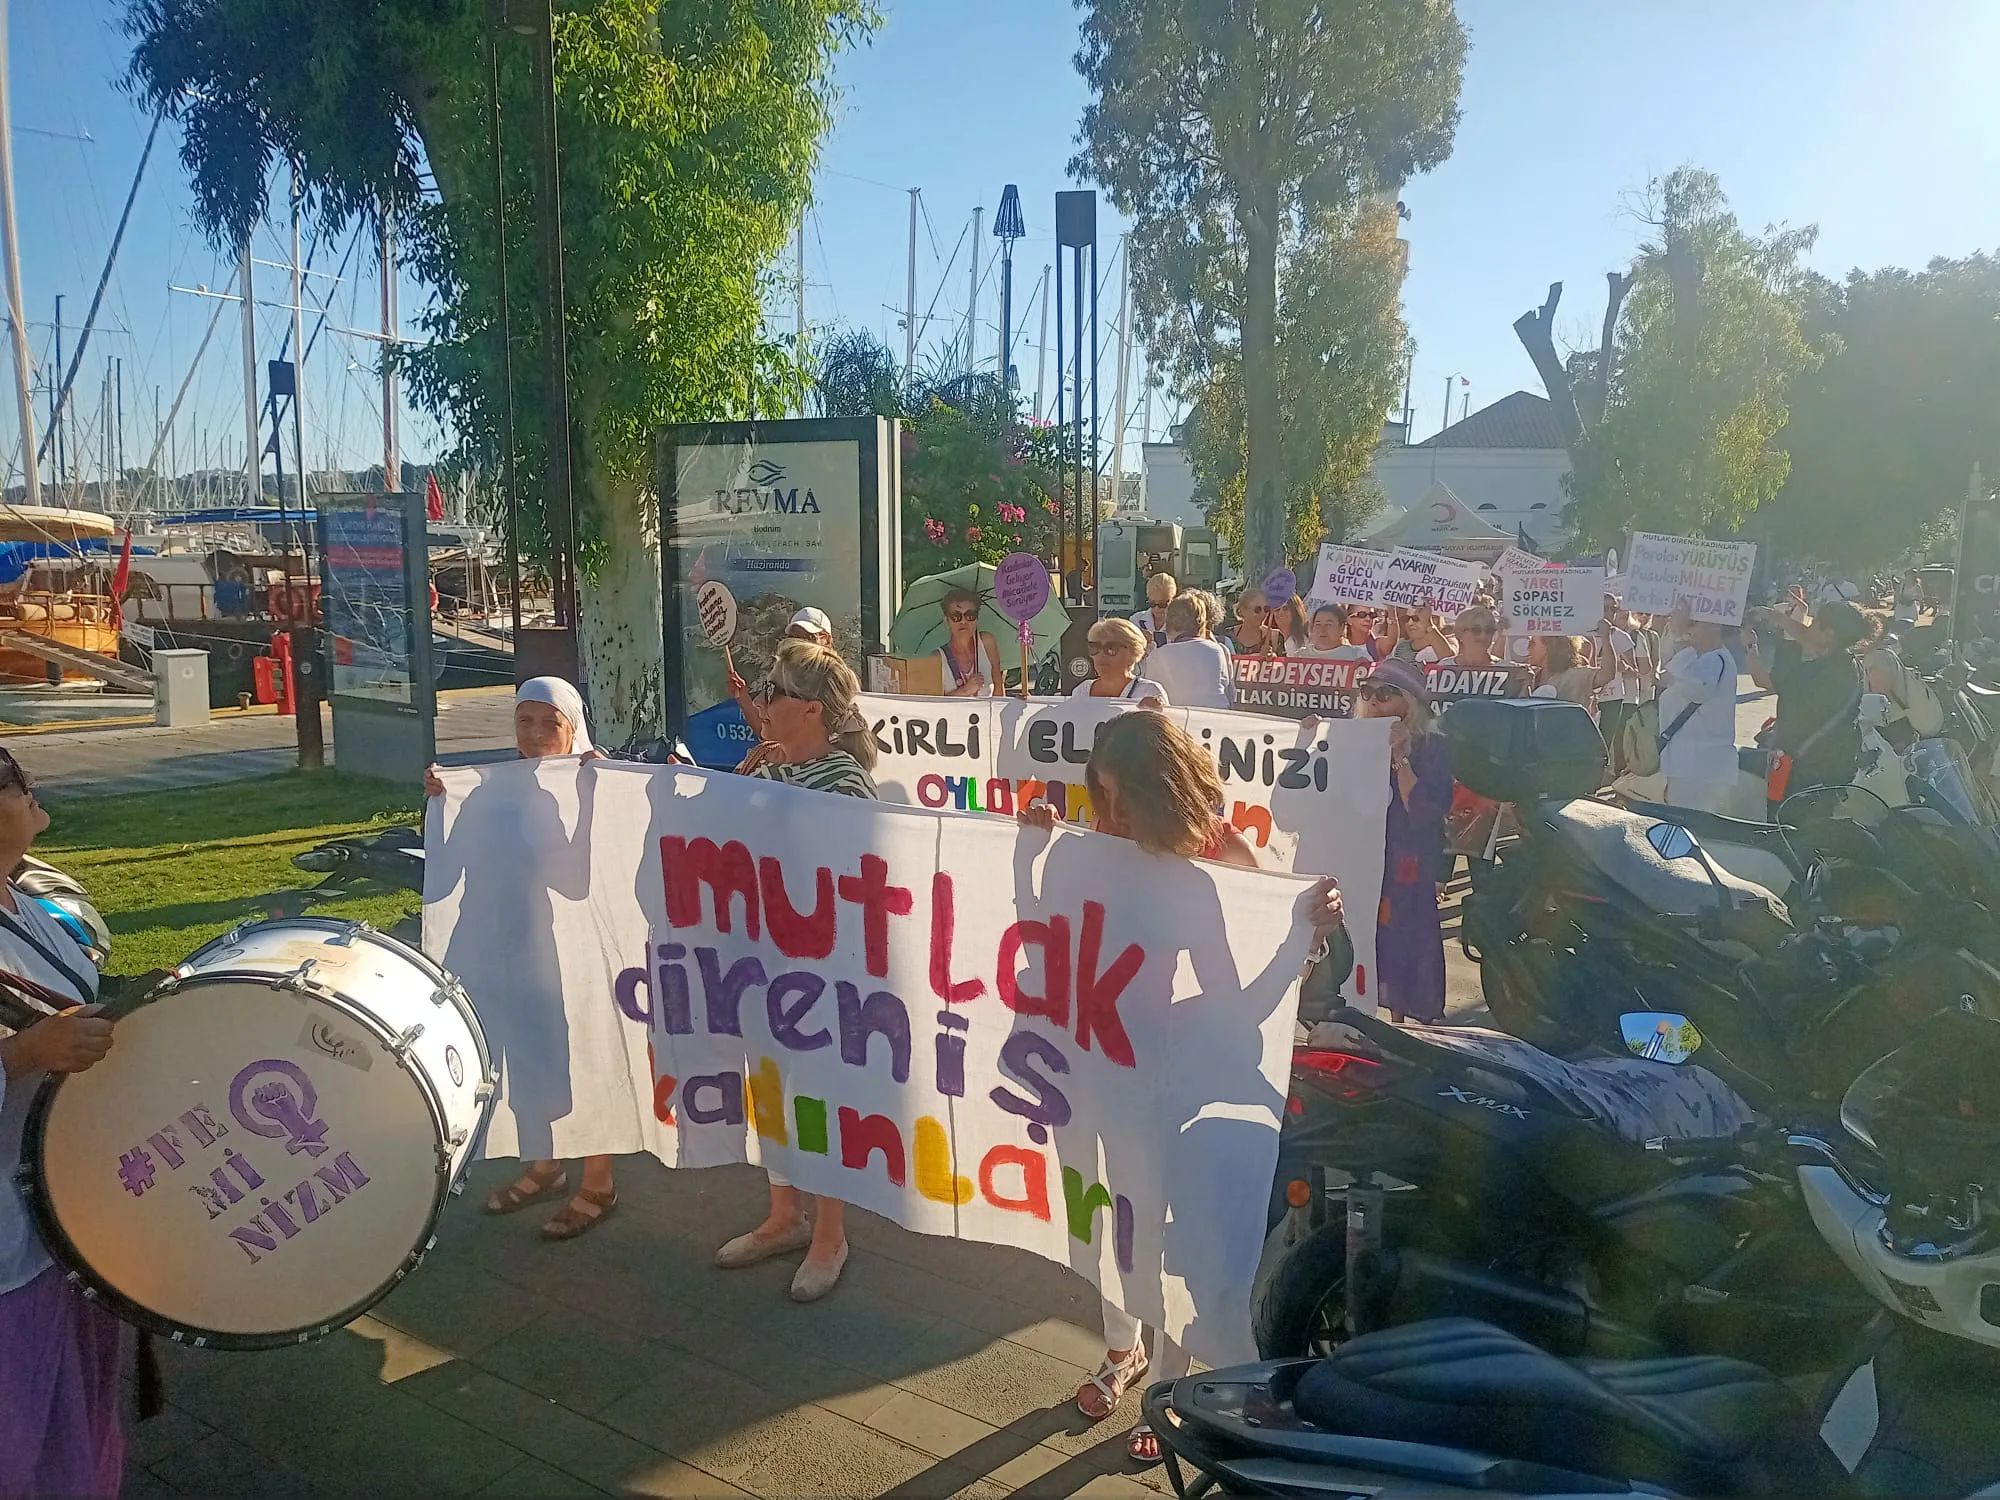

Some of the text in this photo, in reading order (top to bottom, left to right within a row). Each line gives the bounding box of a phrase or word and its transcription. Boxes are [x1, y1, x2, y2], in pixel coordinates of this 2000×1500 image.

[715, 488, 821, 514] REVMA
[1326, 551, 1384, 570] KADININ
[1388, 558, 1437, 575] AYARINI
[1333, 586, 1374, 601] YENER
[1512, 590, 1564, 602] SOPASI
[1512, 604, 1575, 617] SÖKMEZ
[1527, 618, 1562, 631] BİZE
[1277, 687, 1351, 716] DİRENİŞ
[614, 941, 1072, 1146] direniş
